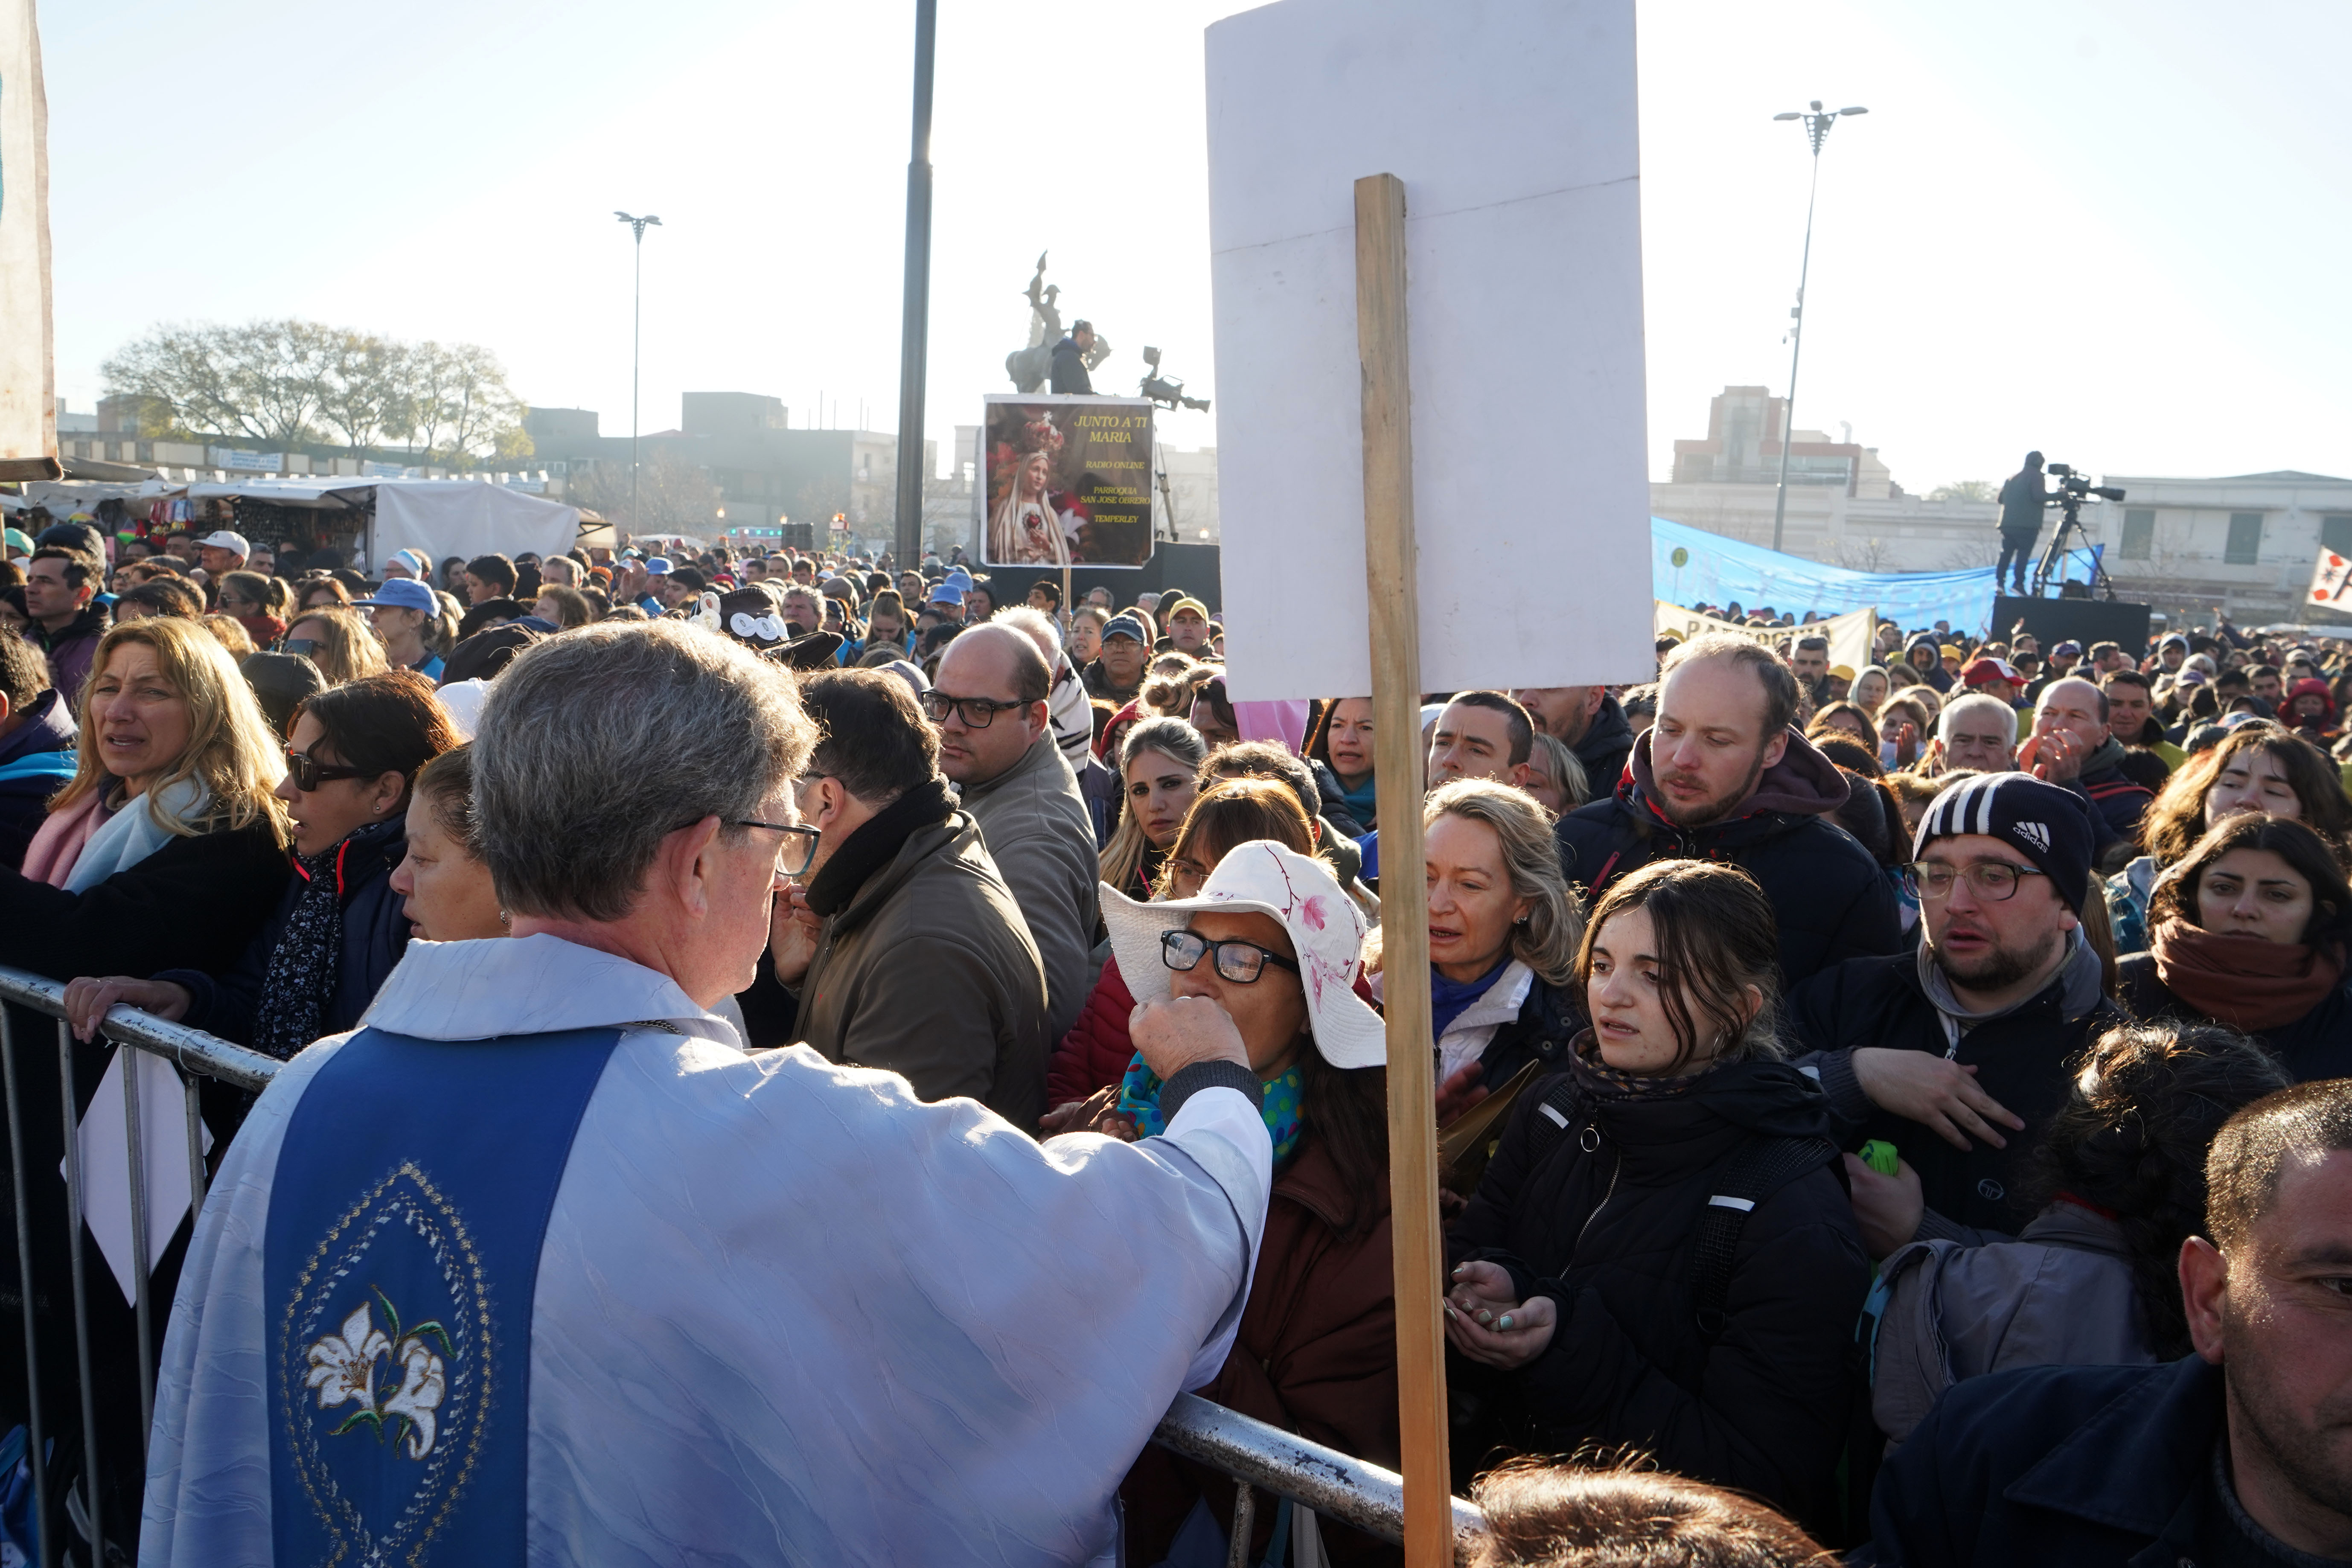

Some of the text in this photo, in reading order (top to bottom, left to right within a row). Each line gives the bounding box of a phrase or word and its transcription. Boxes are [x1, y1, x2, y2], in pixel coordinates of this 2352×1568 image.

[1074, 416, 1147, 428] JUNTO A TI
[1089, 431, 1132, 443] MARIA
[1086, 460, 1112, 468] RADIO
[1093, 486, 1137, 496] PARROQUIA
[1094, 515, 1139, 523] TEMPERLEY
[2013, 827, 2048, 853] adidas
